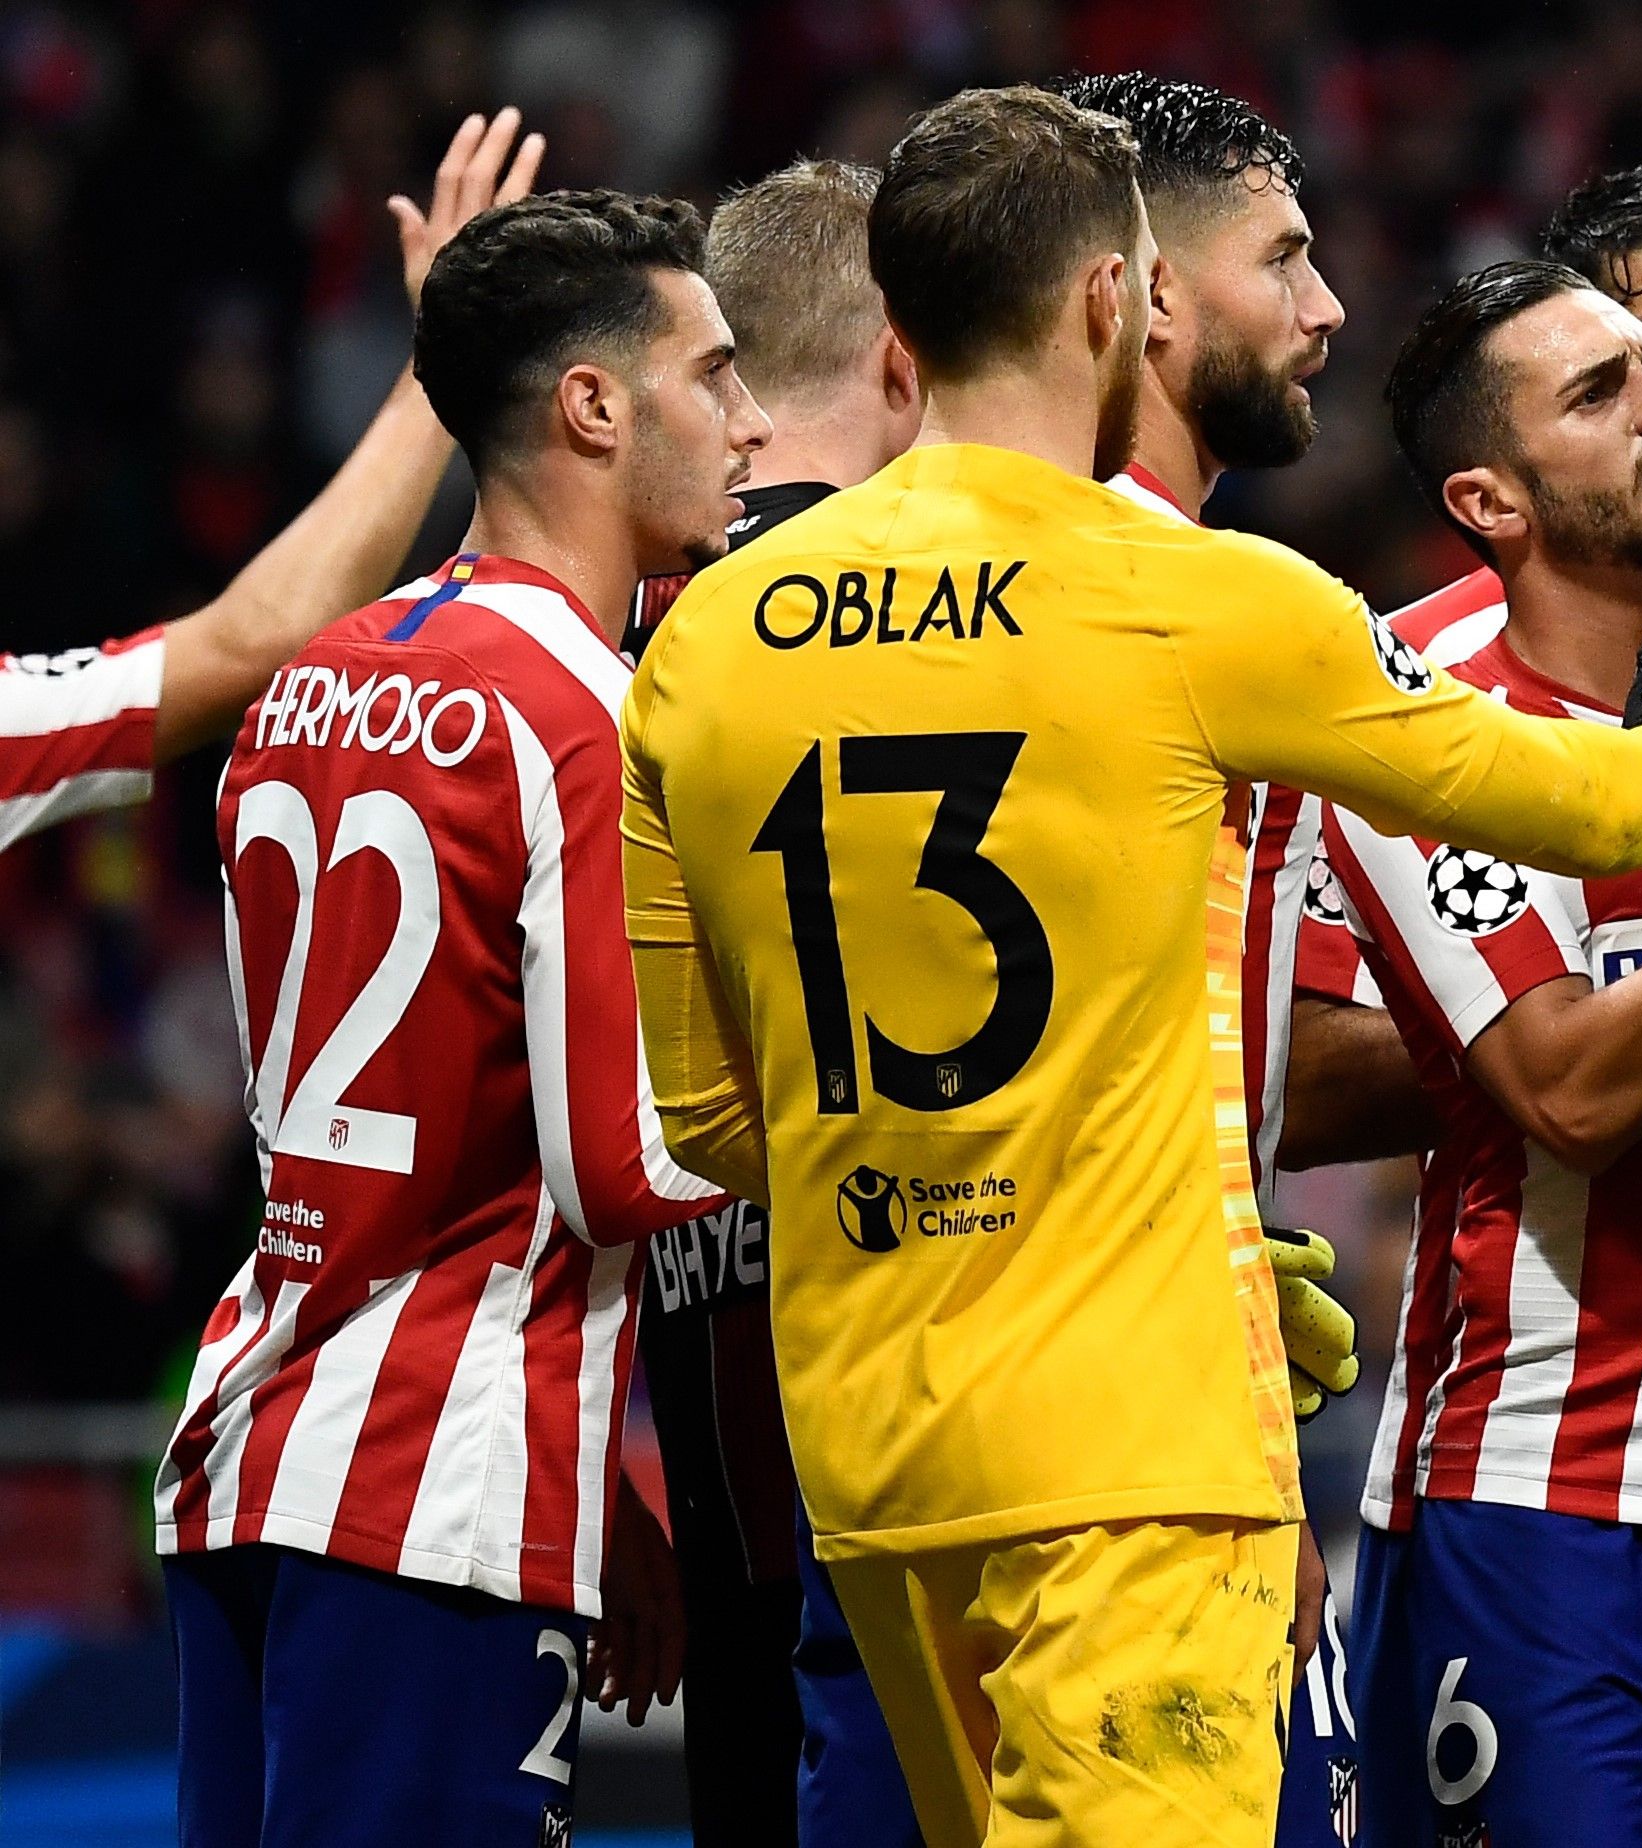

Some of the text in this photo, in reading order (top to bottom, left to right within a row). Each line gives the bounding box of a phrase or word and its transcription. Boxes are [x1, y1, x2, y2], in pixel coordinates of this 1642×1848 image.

[754, 561, 1029, 650] OBLAK
[256, 665, 486, 767] HERMOSO
[749, 731, 1055, 1115] 13
[235, 780, 440, 1175] 22
[264, 1199, 324, 1229] ave the
[908, 1171, 1017, 1203] Save the
[917, 1208, 1017, 1237] Children
[650, 1199, 770, 1314] BAYE
[518, 1629, 579, 1785] 2
[1427, 1657, 1498, 1806] 6
